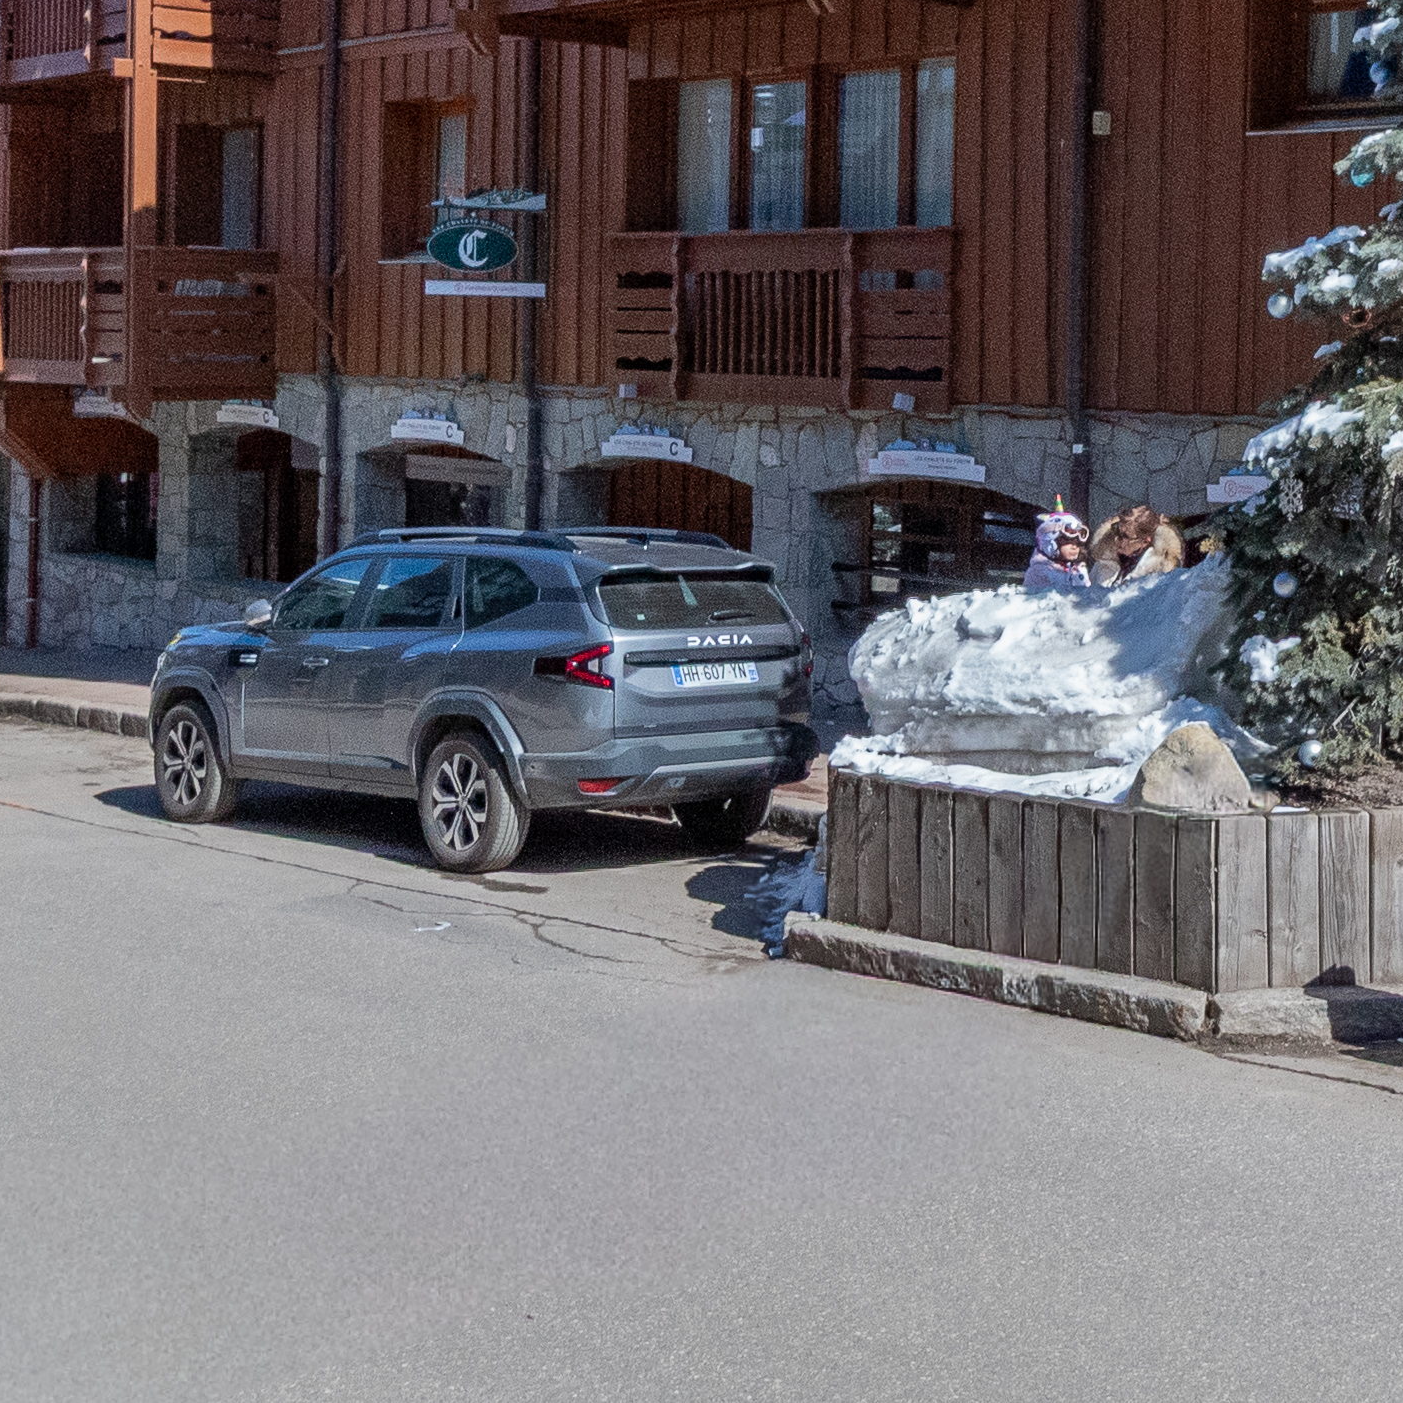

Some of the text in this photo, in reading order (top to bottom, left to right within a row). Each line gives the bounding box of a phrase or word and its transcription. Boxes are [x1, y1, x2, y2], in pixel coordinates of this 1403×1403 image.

[445, 424, 454, 439] C
[669, 441, 679, 456] C
[687, 634, 753, 647] DACIA
